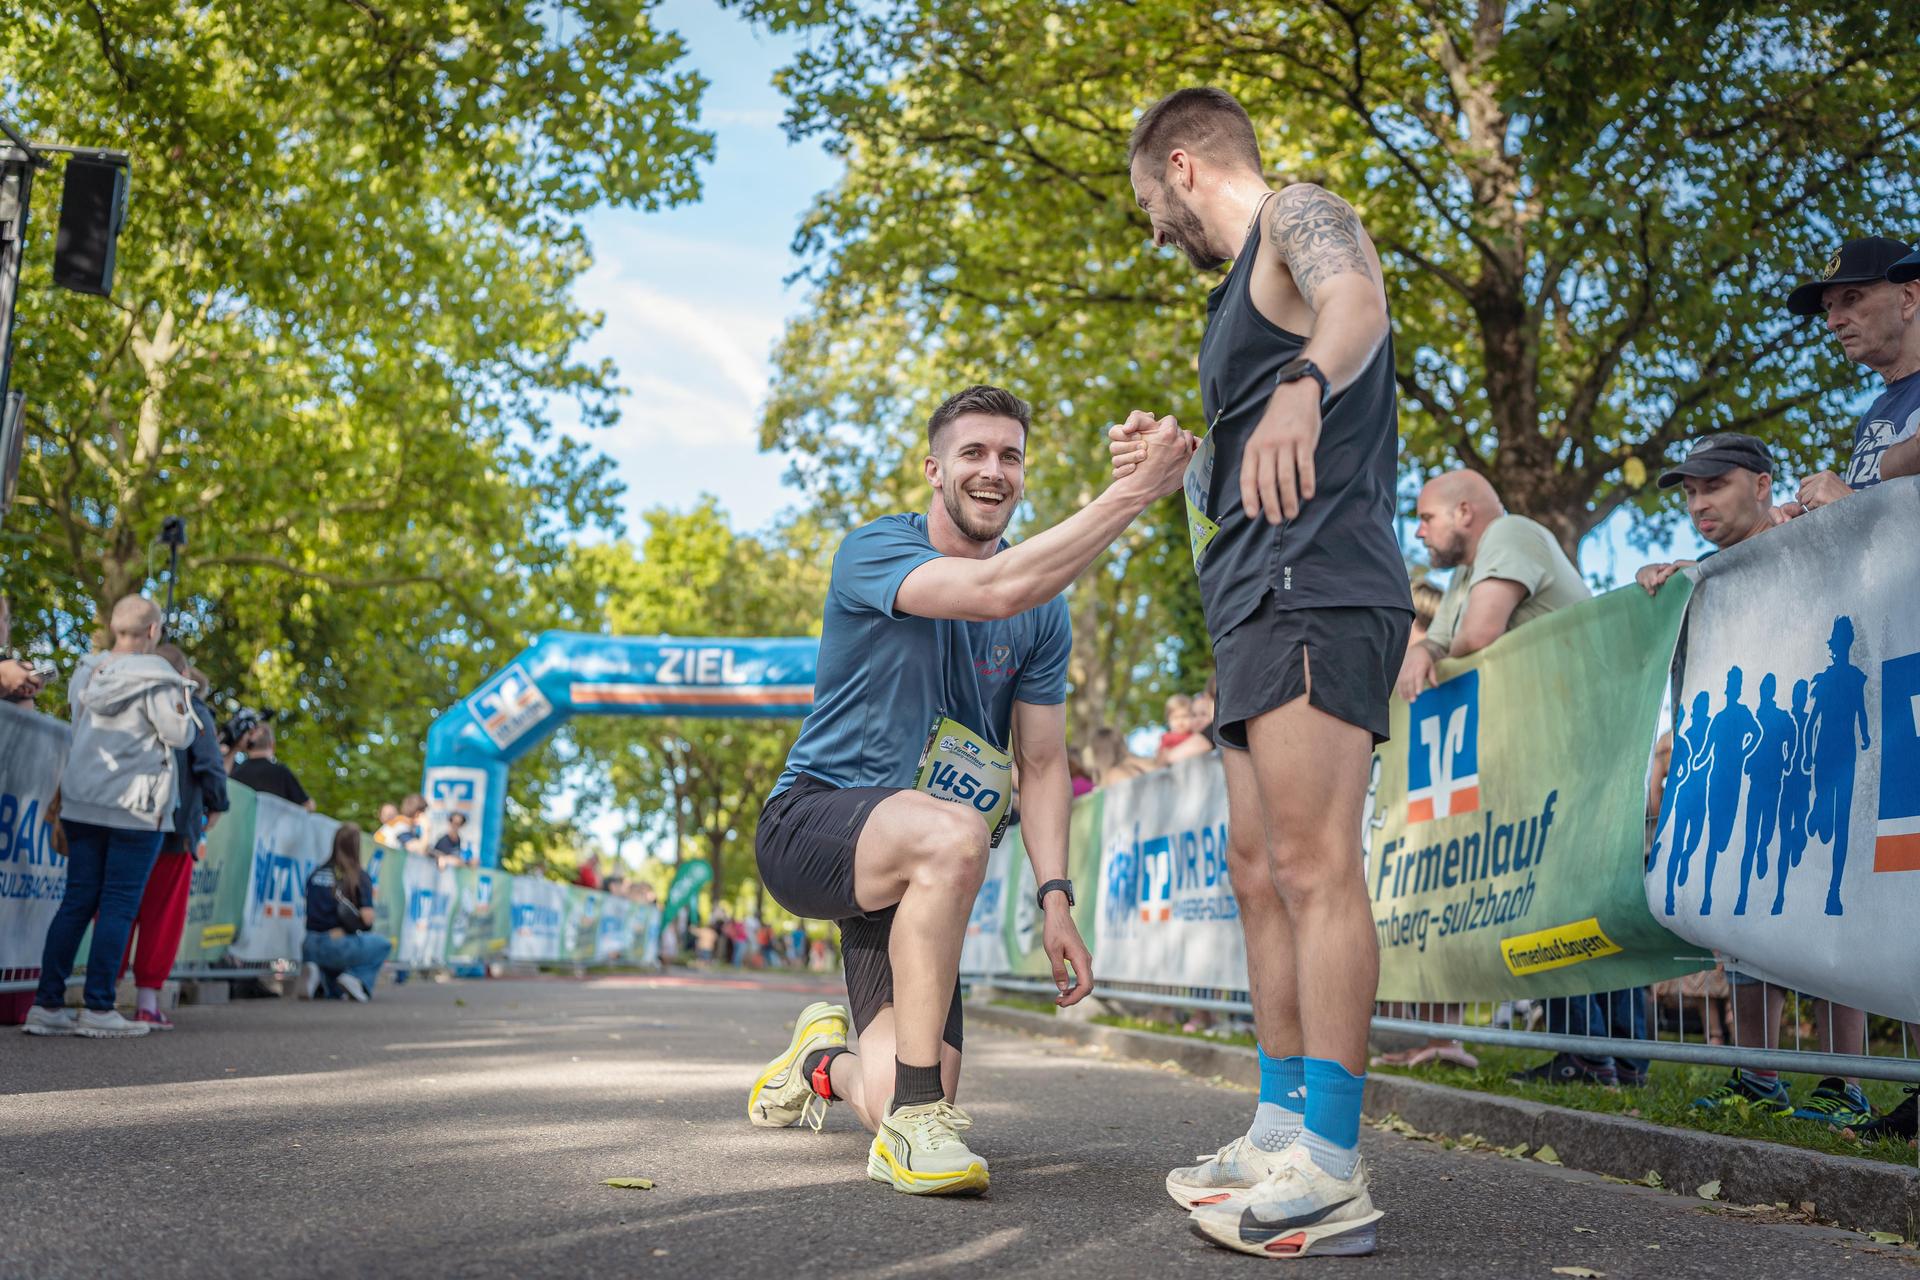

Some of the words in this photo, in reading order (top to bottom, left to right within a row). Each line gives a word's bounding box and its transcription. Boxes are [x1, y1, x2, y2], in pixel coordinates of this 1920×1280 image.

[655, 647, 748, 684] ZIEL
[927, 760, 1000, 813] 1450
[0, 793, 65, 867] BAN
[1172, 830, 1198, 890] VR
[1202, 822, 1231, 886] BA
[1376, 789, 1558, 901] Firmenlauf
[1376, 872, 1537, 952] mberg-sulzbach
[1508, 935, 1610, 969] firmenlauf.bayern
